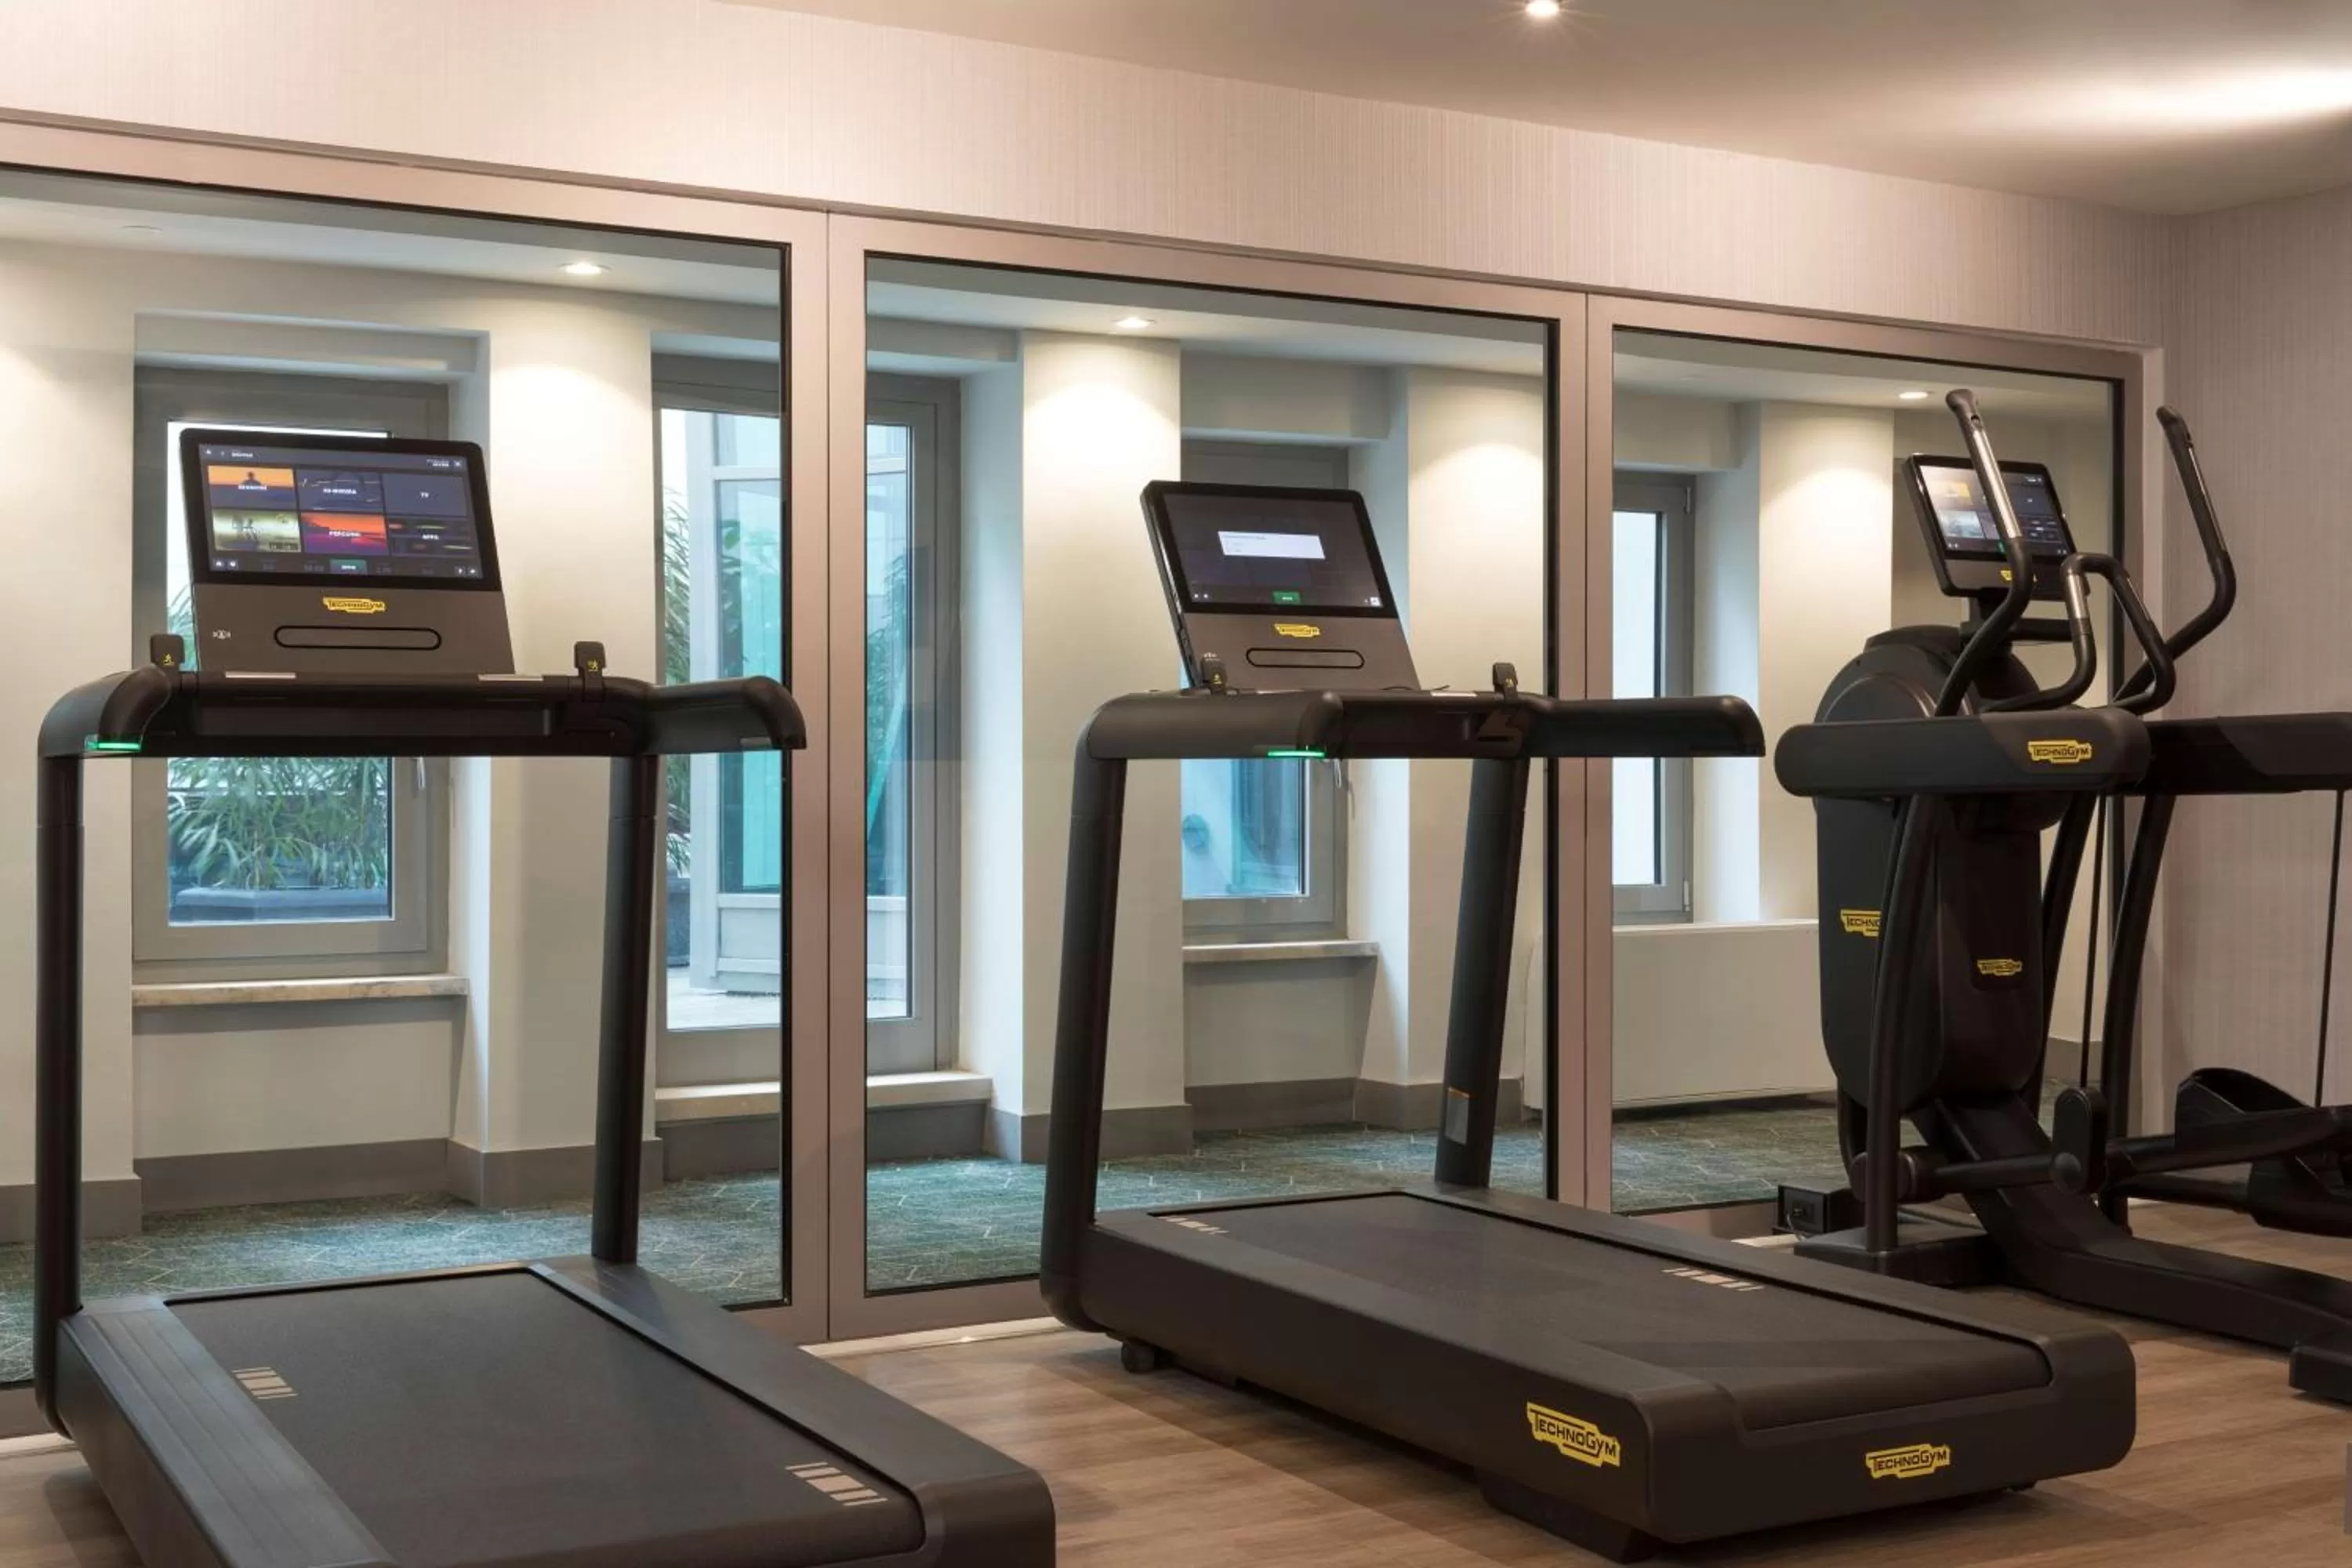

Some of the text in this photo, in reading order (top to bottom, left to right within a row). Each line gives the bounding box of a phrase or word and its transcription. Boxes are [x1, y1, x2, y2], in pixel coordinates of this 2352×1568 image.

[2030, 743, 2090, 760] TECHNOGYM
[1842, 913, 1882, 932] TECHNO
[1530, 1408, 1617, 1458] TECHNOGYM
[1868, 1449, 1947, 1473] TECHNOGYM
